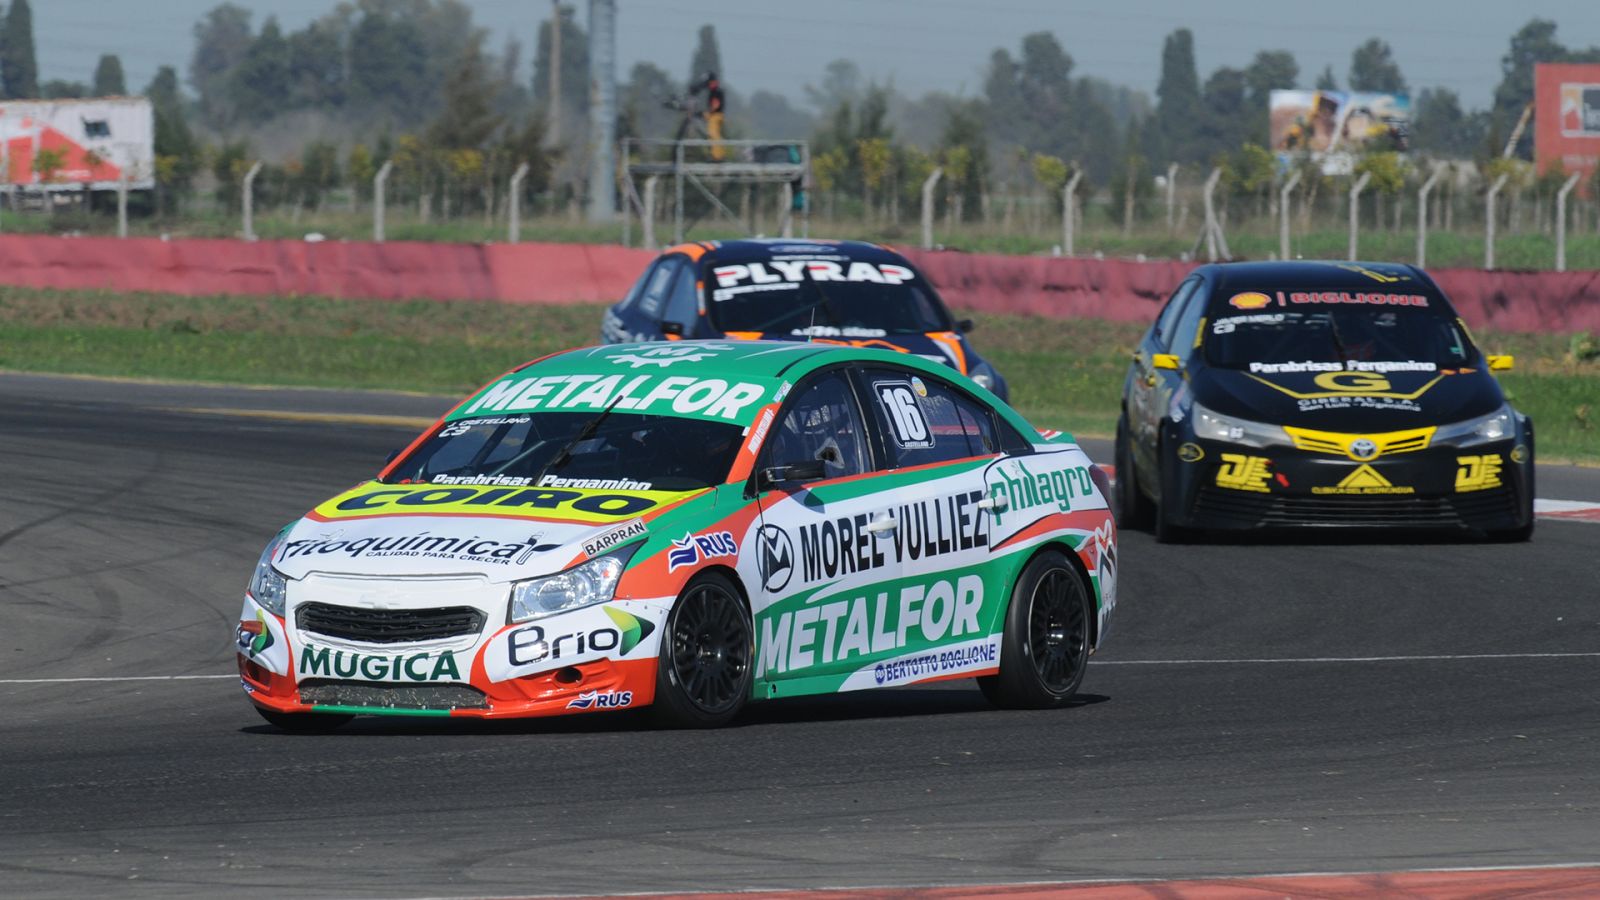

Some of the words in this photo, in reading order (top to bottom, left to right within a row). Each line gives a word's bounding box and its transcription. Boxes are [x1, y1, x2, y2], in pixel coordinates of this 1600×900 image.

[713, 260, 915, 288] PLYRAP
[1290, 292, 1429, 307] BIGLIONE
[1249, 361, 1343, 373] Parabrisas
[1346, 360, 1437, 373] Pergamino
[1313, 371, 1392, 391] G
[464, 374, 765, 419] METALFOR
[459, 417, 531, 426] CASTELLANO
[882, 387, 928, 441] 16
[438, 425, 471, 438] C3
[432, 474, 533, 487] Parabrisas
[537, 475, 653, 490] Pergamino
[336, 488, 658, 515] COIRO
[585, 522, 646, 556] BARPRAN
[696, 531, 736, 557] RUS
[800, 512, 885, 583] MOREL
[888, 490, 988, 563] VULLIEZ
[365, 550, 420, 558] CALIDAD
[423, 551, 456, 559] PARA
[458, 554, 510, 566] CRECER
[755, 574, 985, 679] METALFOR
[507, 625, 619, 667] Brio
[299, 643, 461, 682] MUGICA
[886, 654, 938, 681] BERTOTTO
[940, 643, 996, 671] BOGLIONE
[595, 691, 632, 708] RUS
